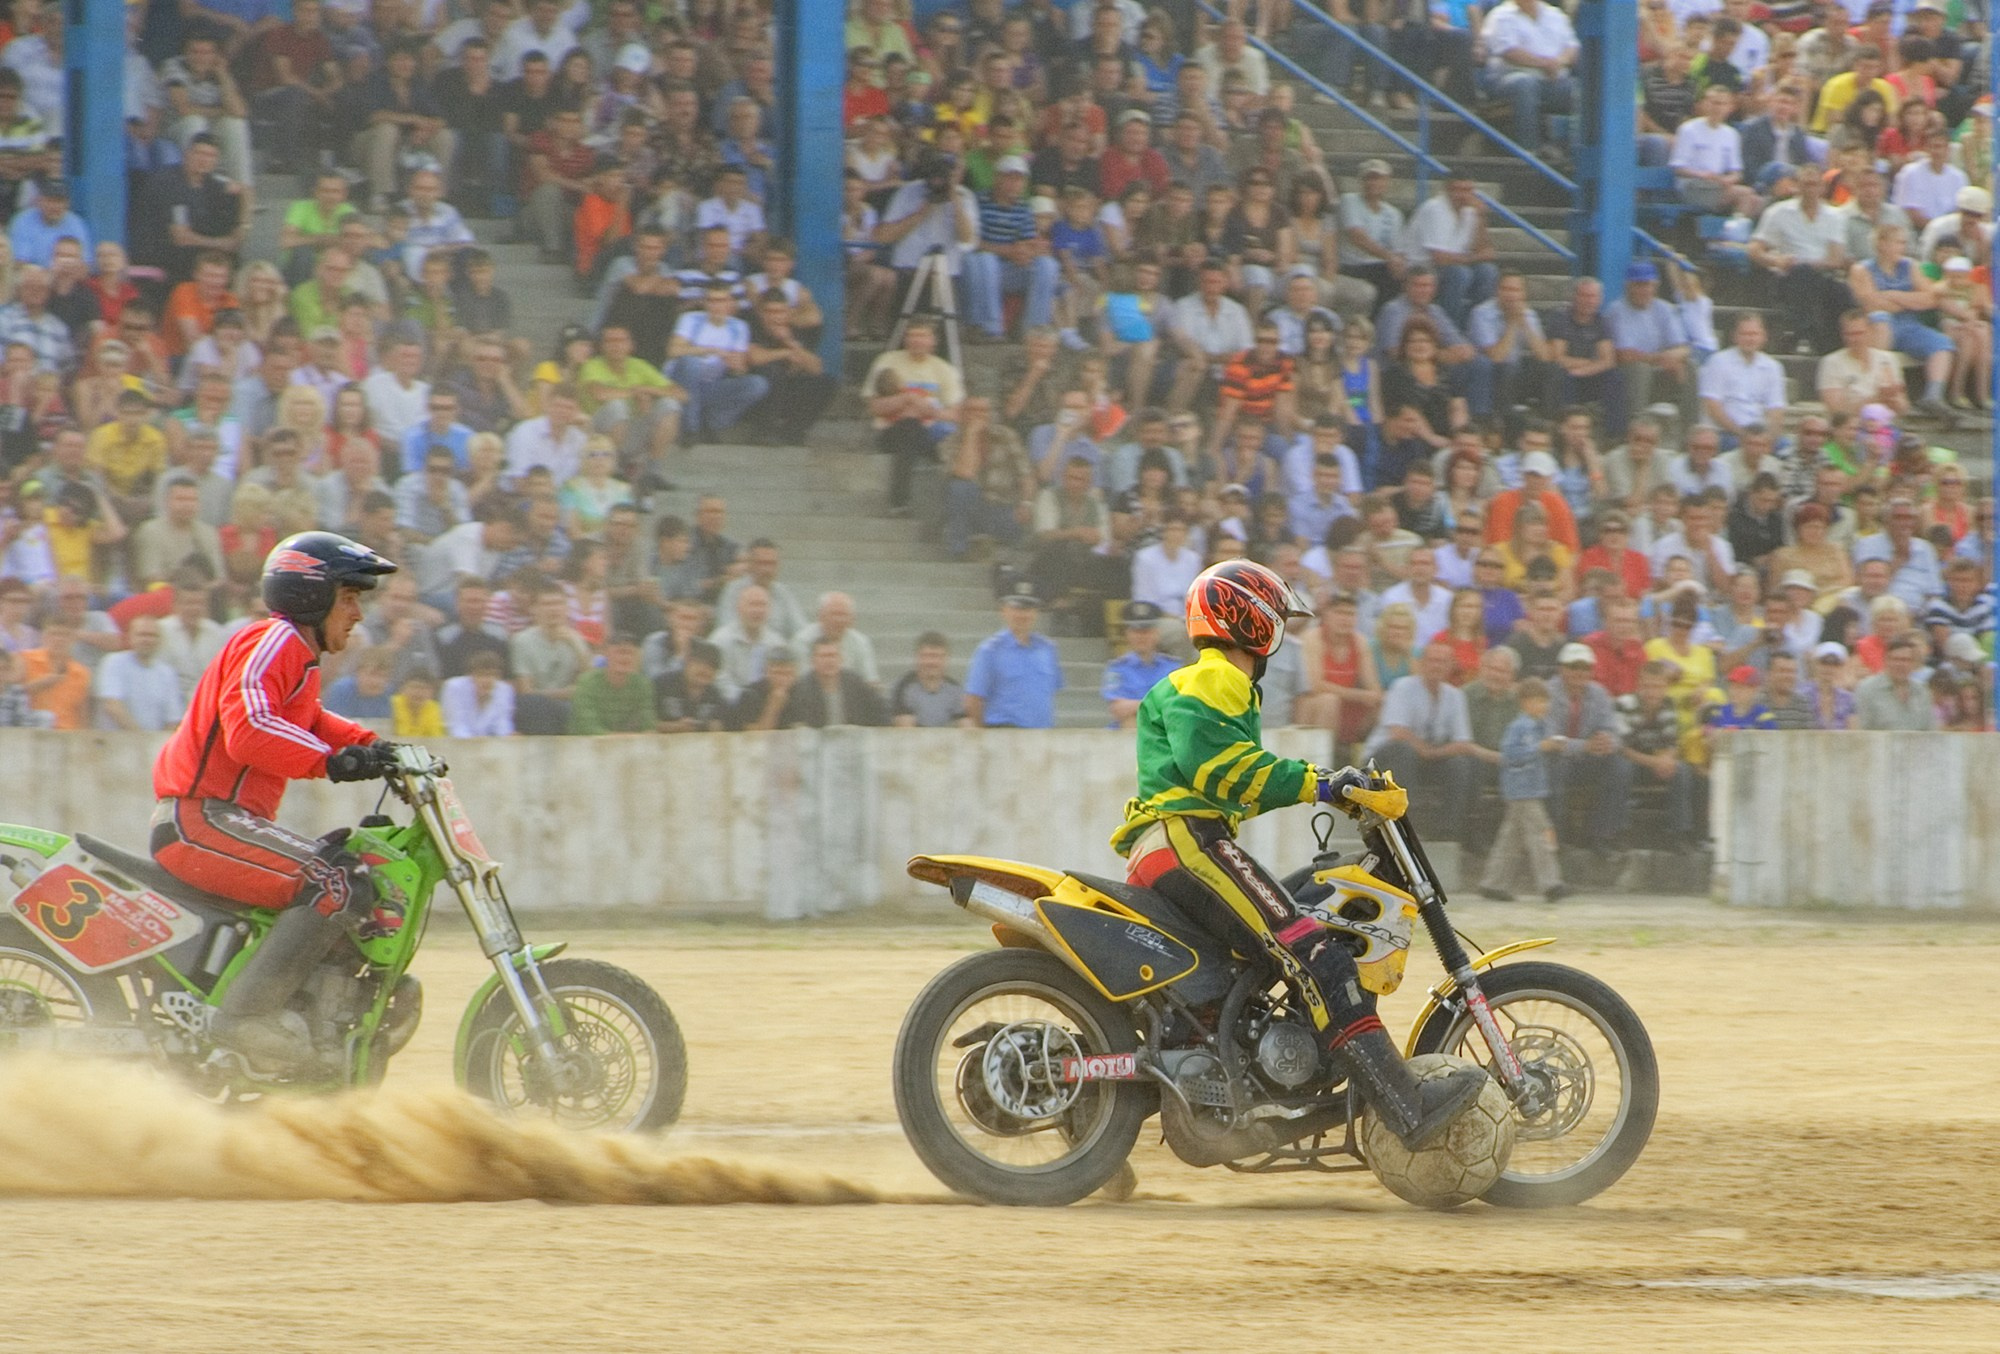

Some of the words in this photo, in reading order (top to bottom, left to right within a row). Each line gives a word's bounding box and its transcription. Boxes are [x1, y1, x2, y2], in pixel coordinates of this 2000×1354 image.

[37, 878, 105, 942] 3
[1216, 839, 1288, 919] alpinestars
[1262, 931, 1320, 1007] ainears
[1069, 1056, 1136, 1079] MOTU
